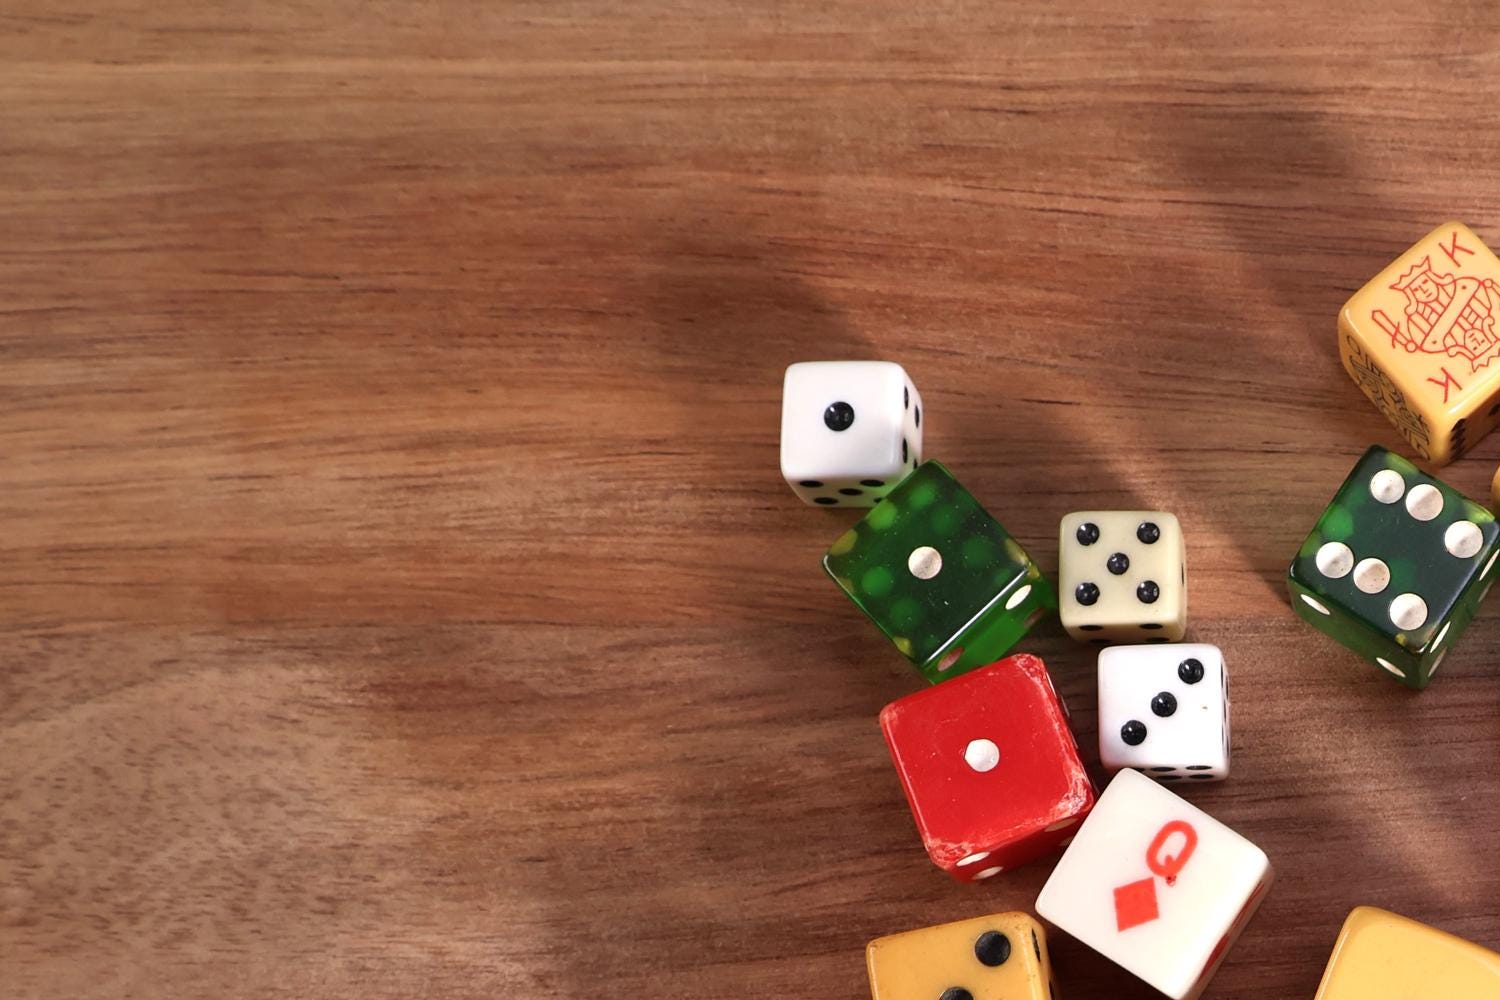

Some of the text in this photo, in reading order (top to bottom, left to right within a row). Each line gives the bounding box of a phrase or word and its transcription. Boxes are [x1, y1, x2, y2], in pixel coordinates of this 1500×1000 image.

[1438, 231, 1475, 268] K
[1427, 366, 1463, 403] K
[1146, 820, 1198, 887] Q
